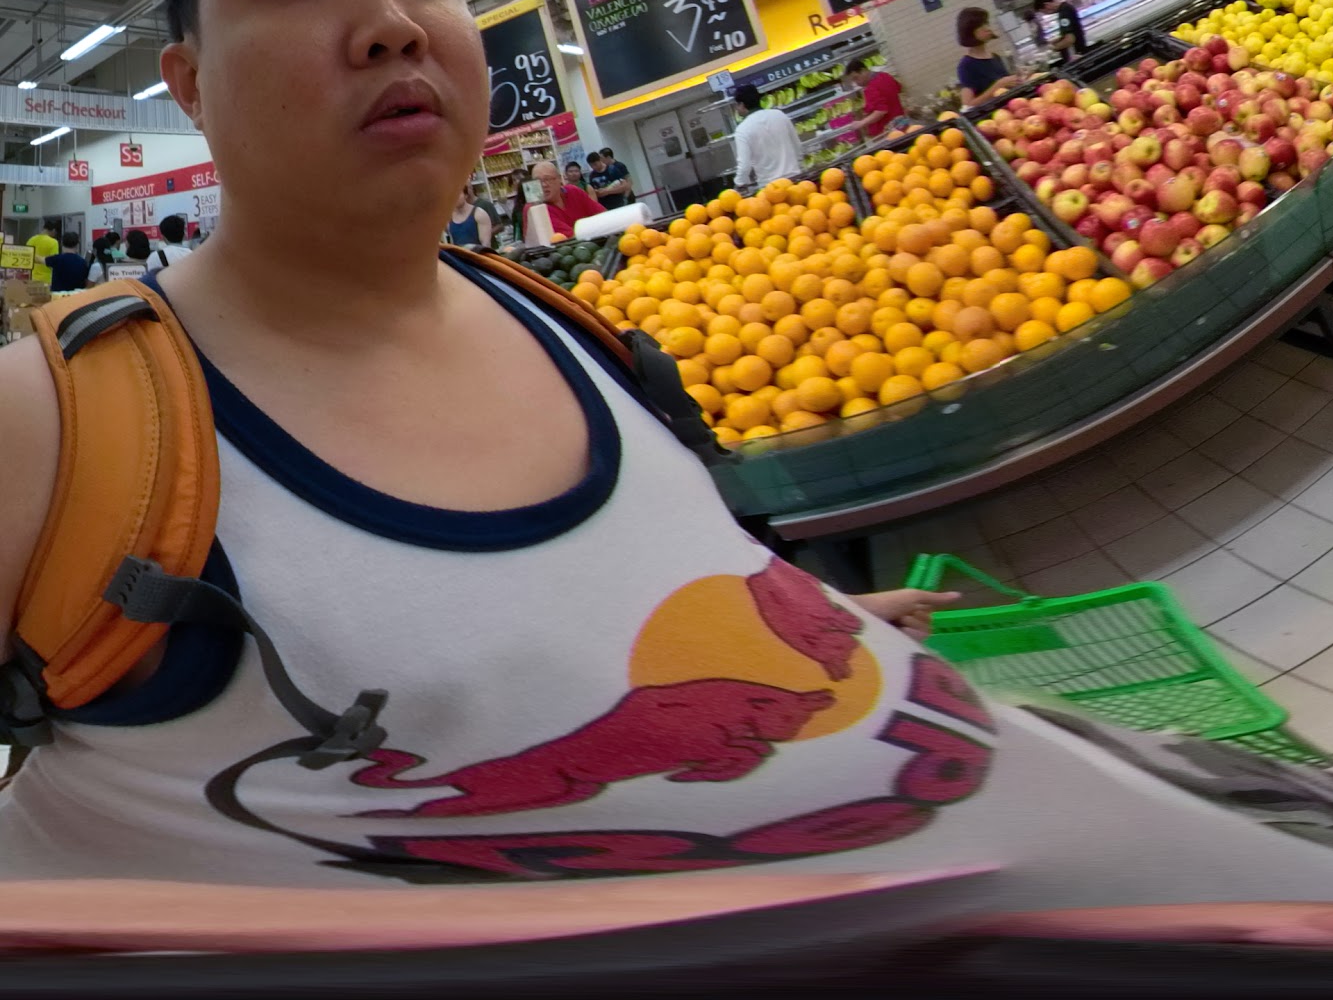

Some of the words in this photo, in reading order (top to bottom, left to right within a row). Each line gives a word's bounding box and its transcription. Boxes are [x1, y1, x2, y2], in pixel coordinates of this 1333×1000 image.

[480, 6, 520, 25] SPECIAL
[724, 30, 747, 51] 10
[767, 66, 792, 81] DELI
[25, 97, 127, 121] Self-Checkout
[533, 87, 556, 117] 3
[121, 144, 143, 164] S5
[69, 163, 89, 178] S6
[102, 182, 155, 203] SELF-CHECKOUT
[201, 194, 217, 206] EASY
[193, 195, 201, 218] 3
[201, 205, 219, 215] STEPS
[121, 270, 146, 278] Trolley
